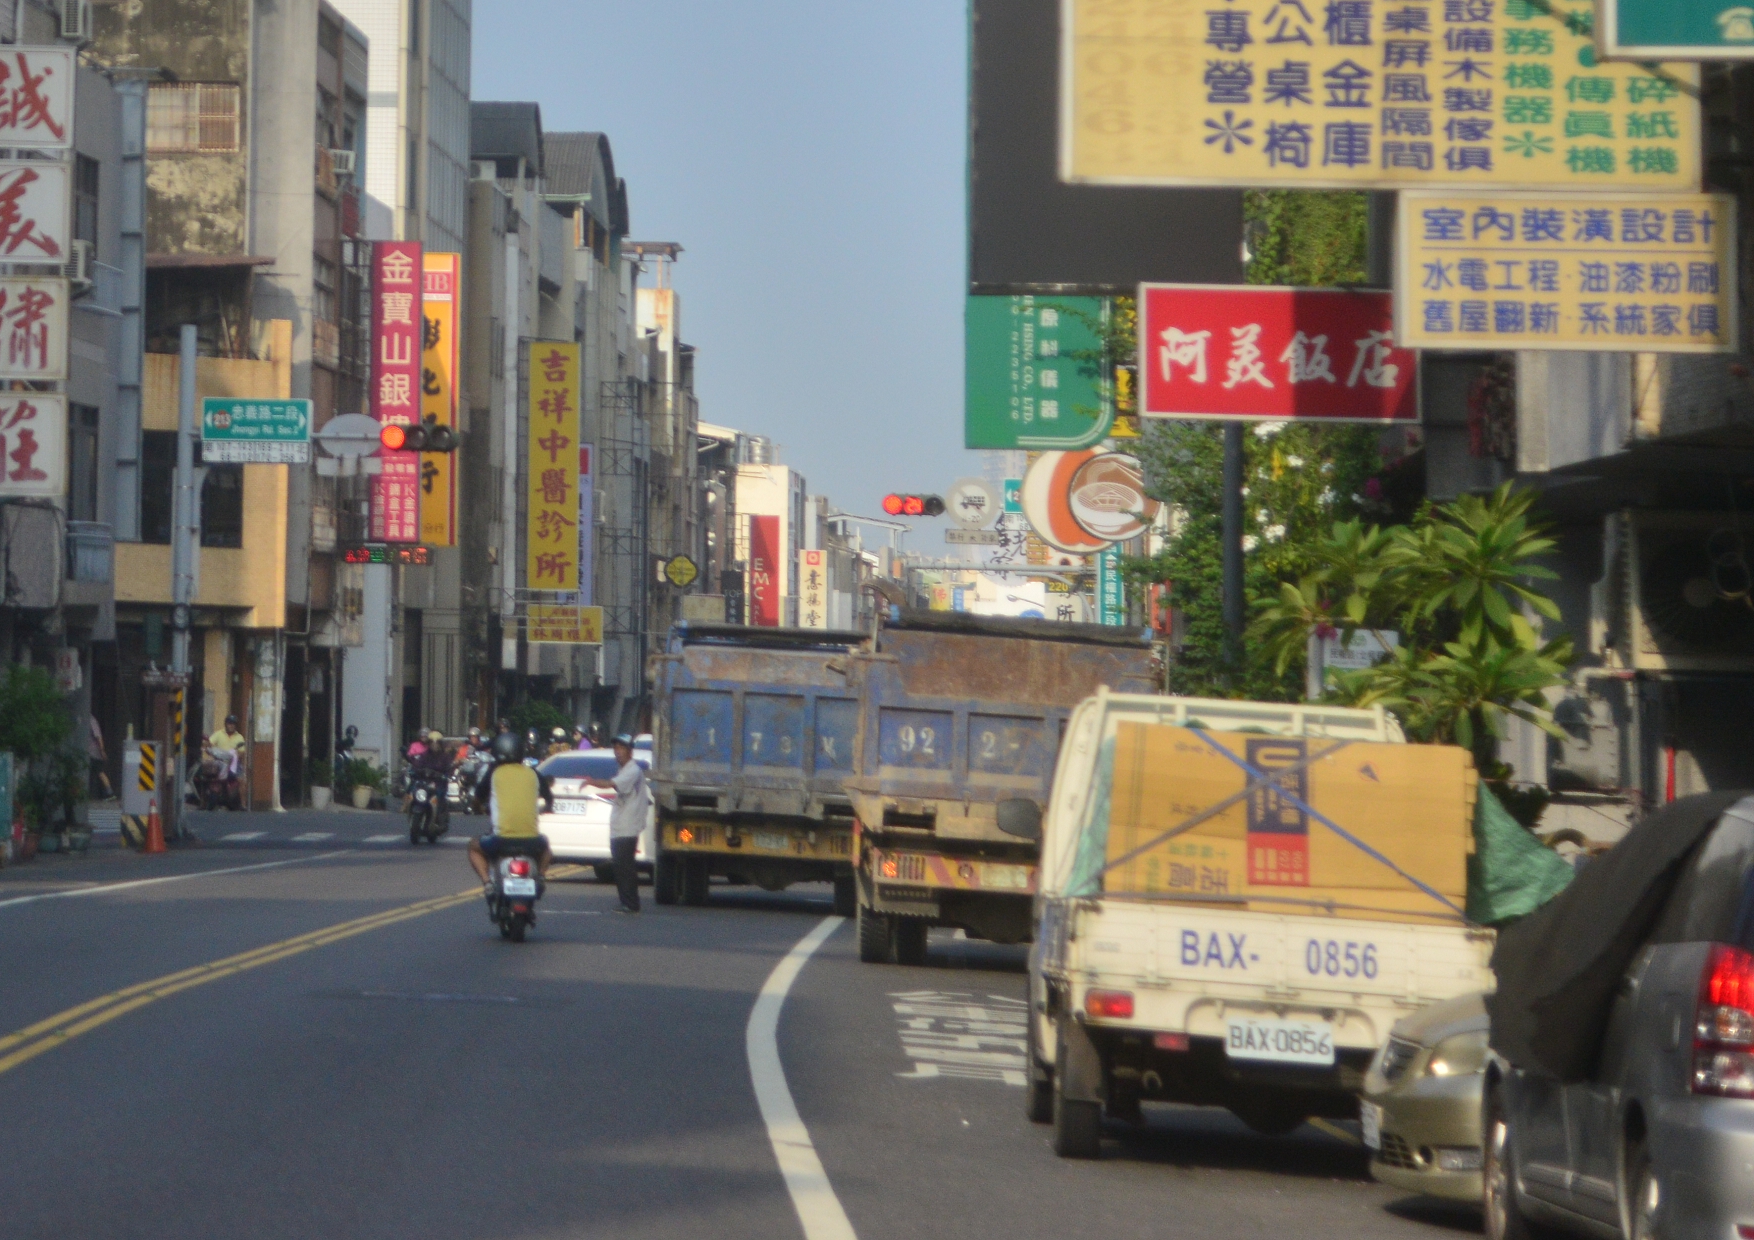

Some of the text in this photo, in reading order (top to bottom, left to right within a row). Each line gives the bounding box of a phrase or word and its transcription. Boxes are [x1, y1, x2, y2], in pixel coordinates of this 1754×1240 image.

[1420, 208, 1717, 246] 室內裝潢設計
[1158, 324, 1400, 390] 阿美飯店
[535, 349, 576, 585] 吉祥中醫診所
[1305, 937, 1380, 981] 0856
